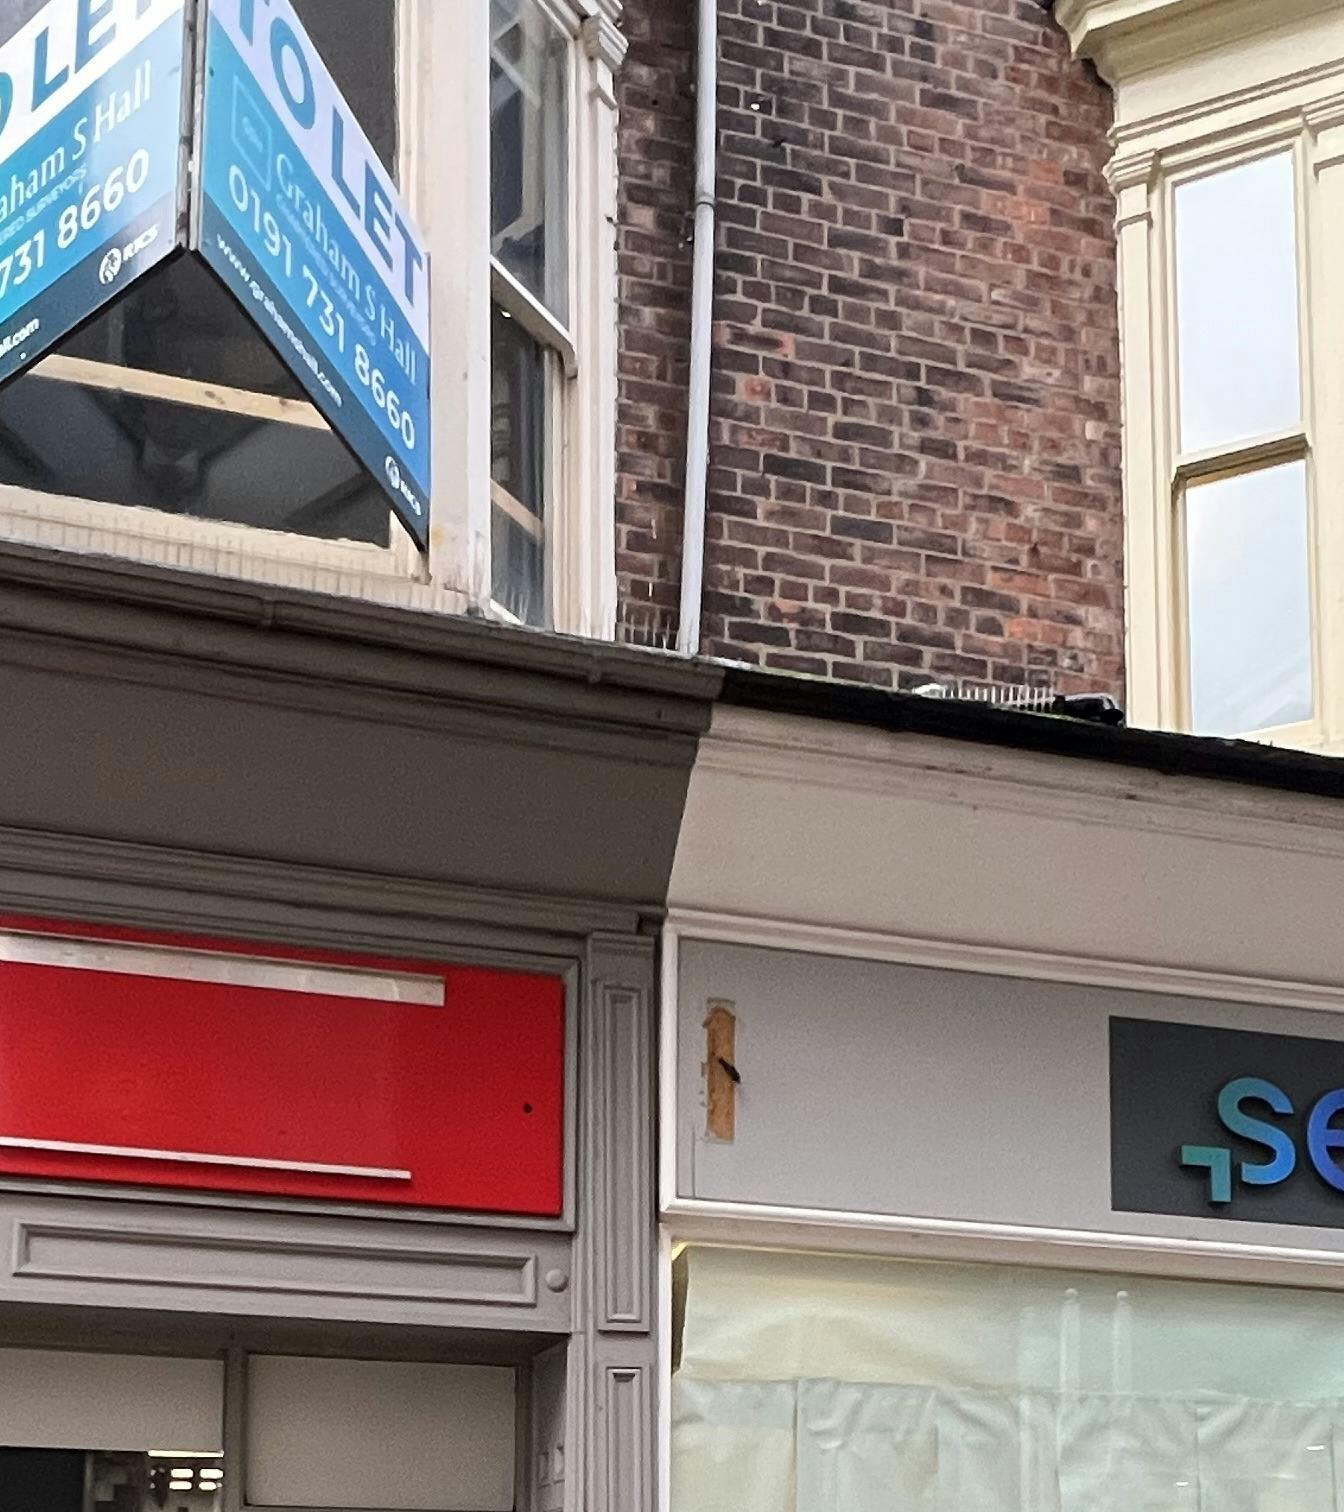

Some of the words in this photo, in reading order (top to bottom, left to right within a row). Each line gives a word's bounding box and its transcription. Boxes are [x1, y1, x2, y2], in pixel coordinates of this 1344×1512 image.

[31, 0, 153, 112] LE
[72, 117, 87, 161] S
[93, 59, 152, 143] Hall
[57, 148, 149, 249] 8660
[276, 153, 360, 301] Graham
[365, 284, 376, 321] S
[380, 303, 416, 384] Hall
[331, 105, 423, 307] LET
[229, 164, 292, 278] 0191
[302, 264, 345, 352] 731
[354, 343, 416, 450] 8660
